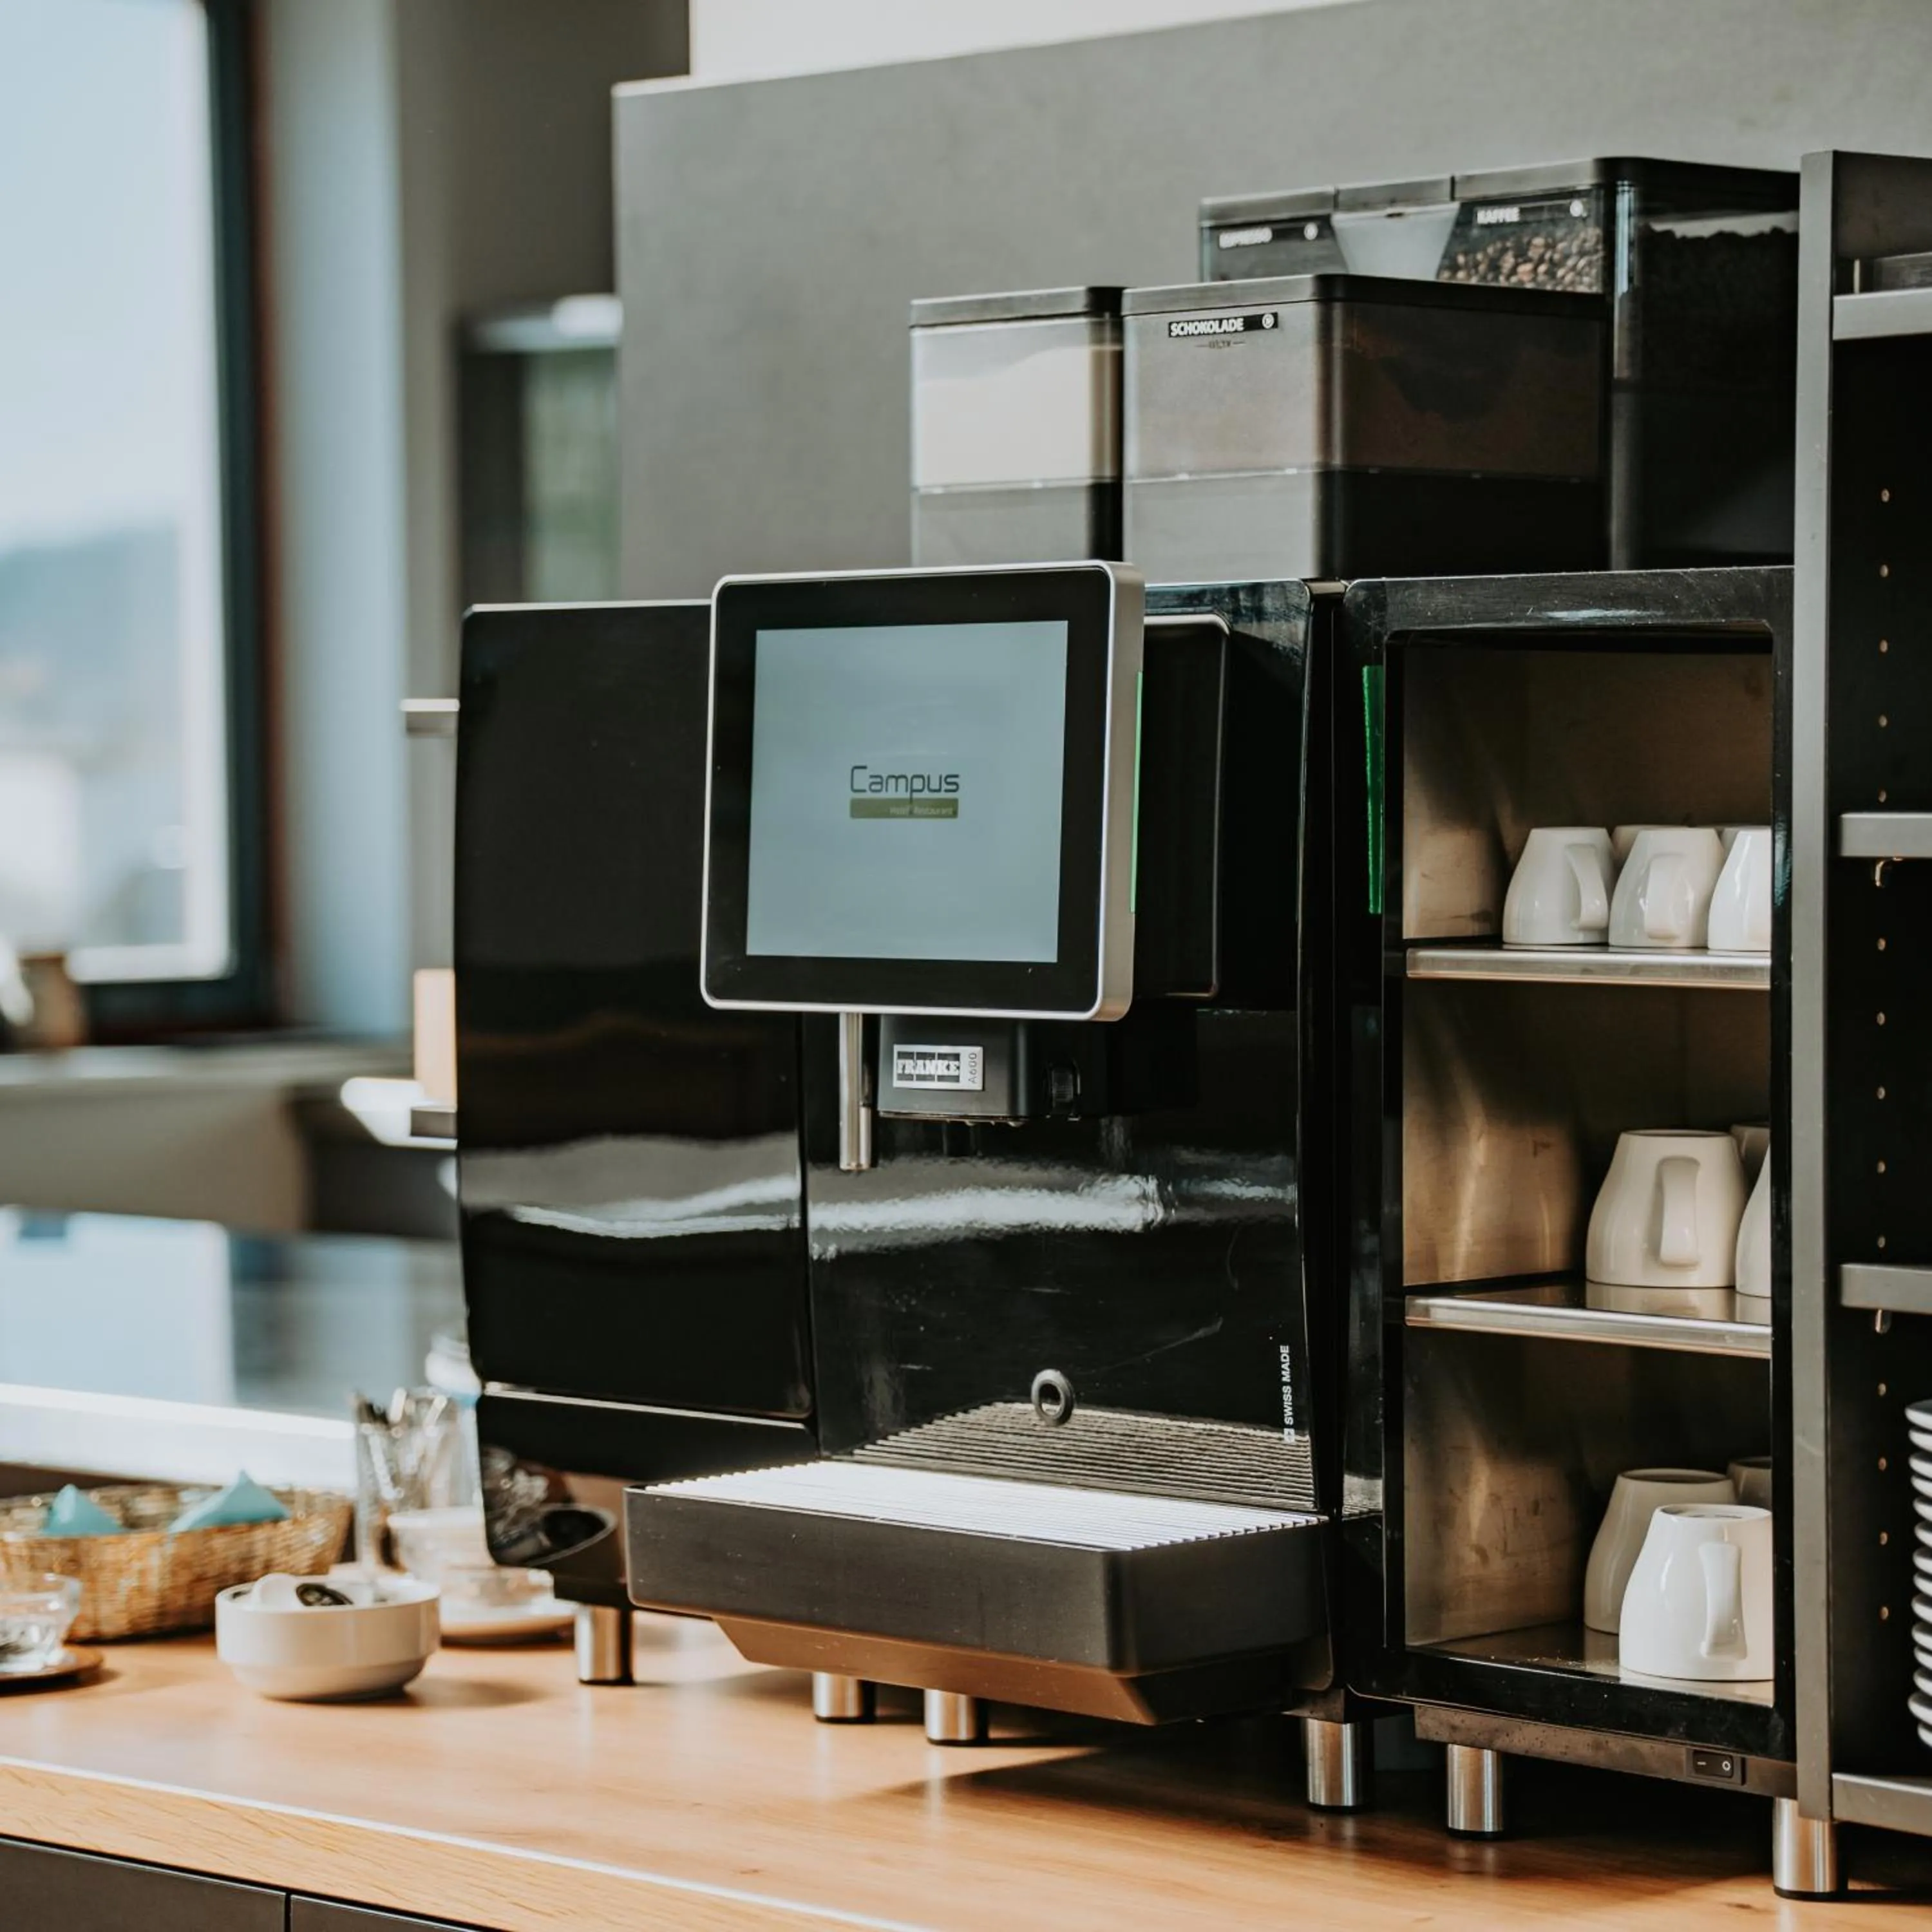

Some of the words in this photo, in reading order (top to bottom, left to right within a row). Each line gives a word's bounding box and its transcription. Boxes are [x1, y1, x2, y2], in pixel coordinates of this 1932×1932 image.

[1170, 317, 1245, 337] SCHOKOLADE
[850, 765, 960, 805] Campus
[896, 1059, 960, 1076] FRANKE
[968, 1052, 978, 1084] A600
[1280, 1345, 1291, 1383] MADE
[1282, 1385, 1294, 1425] SWISS
